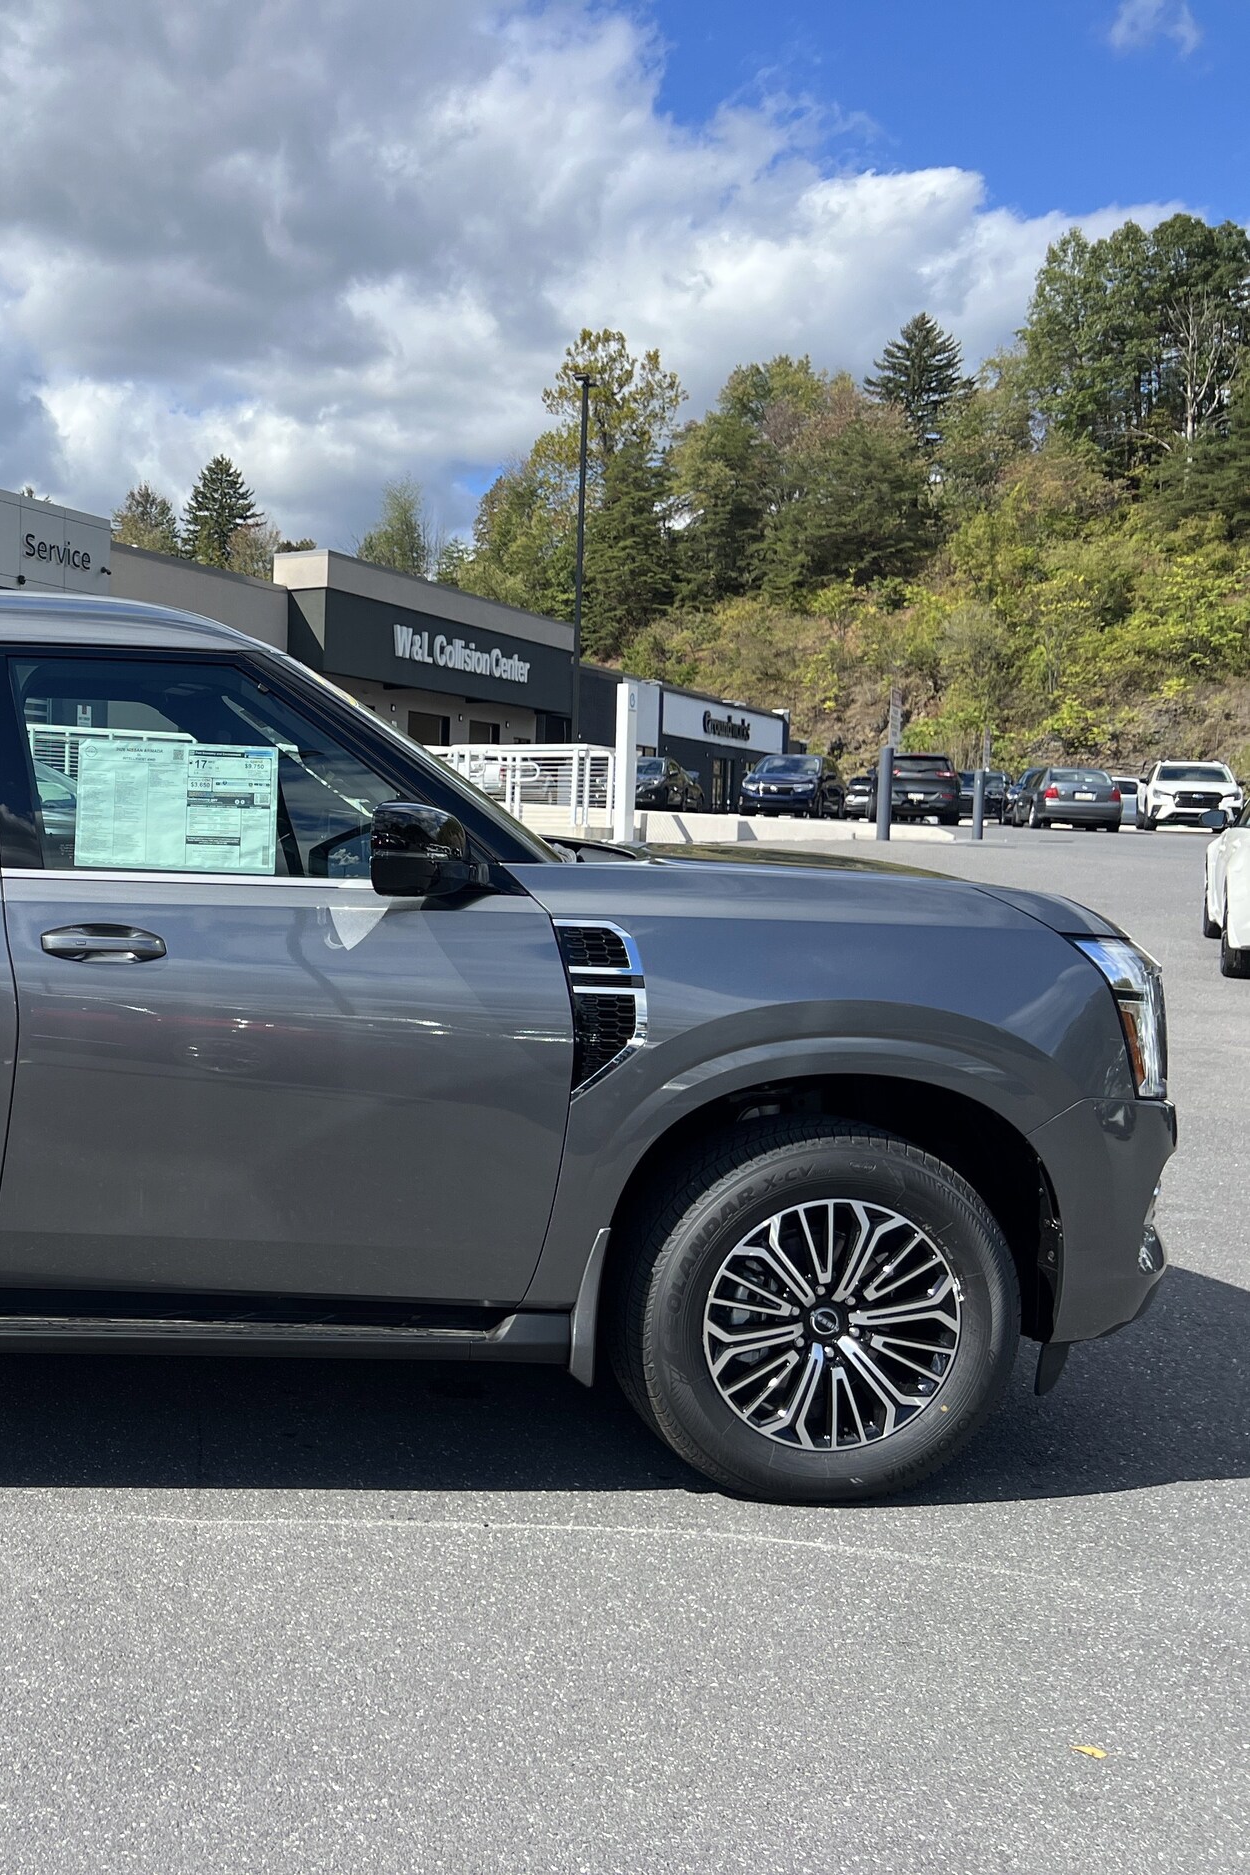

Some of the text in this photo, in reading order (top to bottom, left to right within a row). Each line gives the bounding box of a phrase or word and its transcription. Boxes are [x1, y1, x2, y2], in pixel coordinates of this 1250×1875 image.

[23, 533, 91, 570] Service
[393, 624, 531, 683] W&L Collision Center
[195, 759, 207, 769] 17
